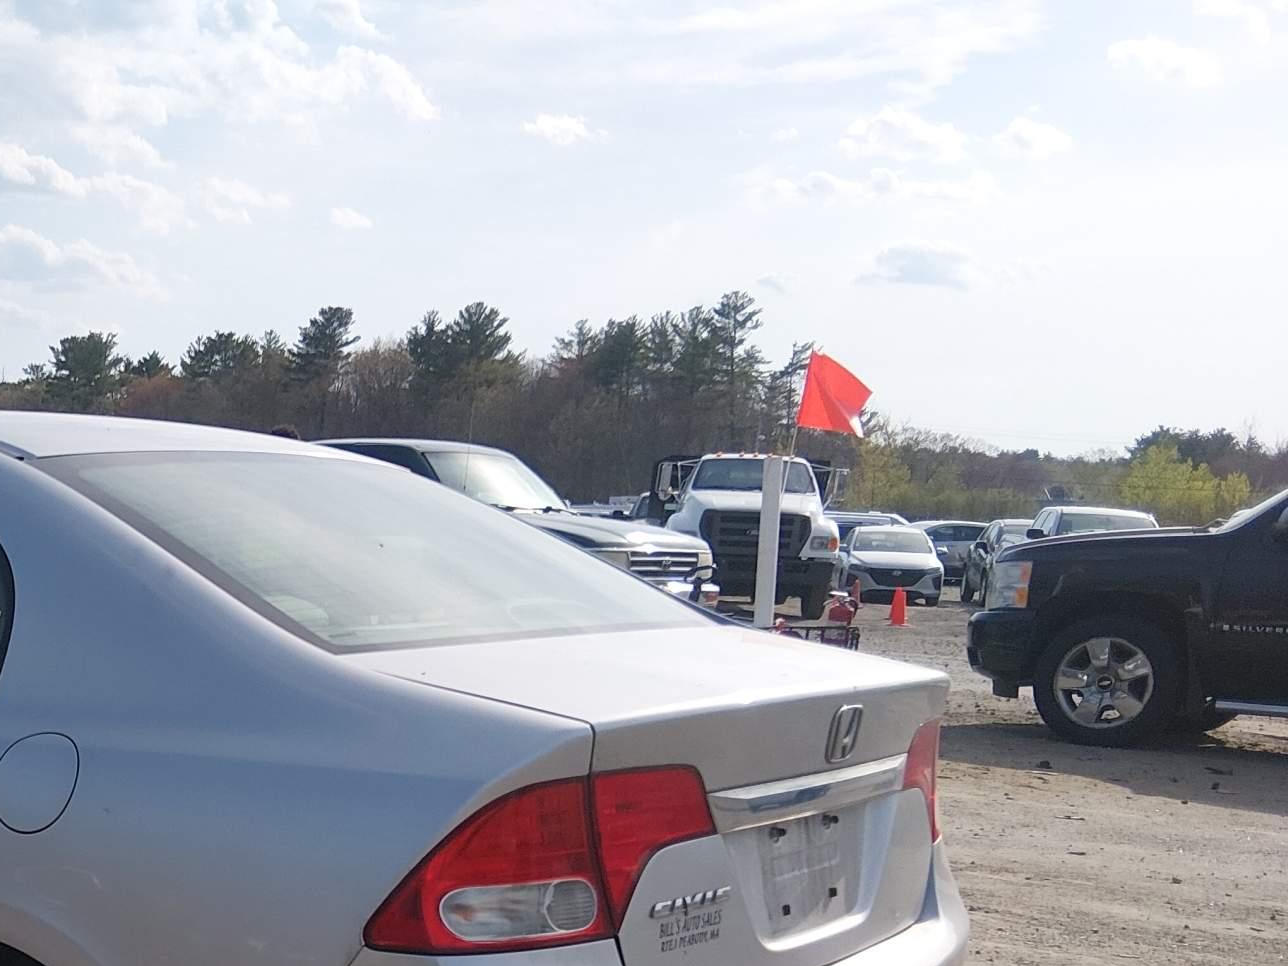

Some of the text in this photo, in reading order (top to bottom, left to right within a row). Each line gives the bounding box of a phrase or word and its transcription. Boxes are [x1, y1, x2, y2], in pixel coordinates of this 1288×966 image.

[649, 886, 731, 918] CIVIC
[681, 914, 700, 933] AUTO
[700, 908, 722, 929] SALES
